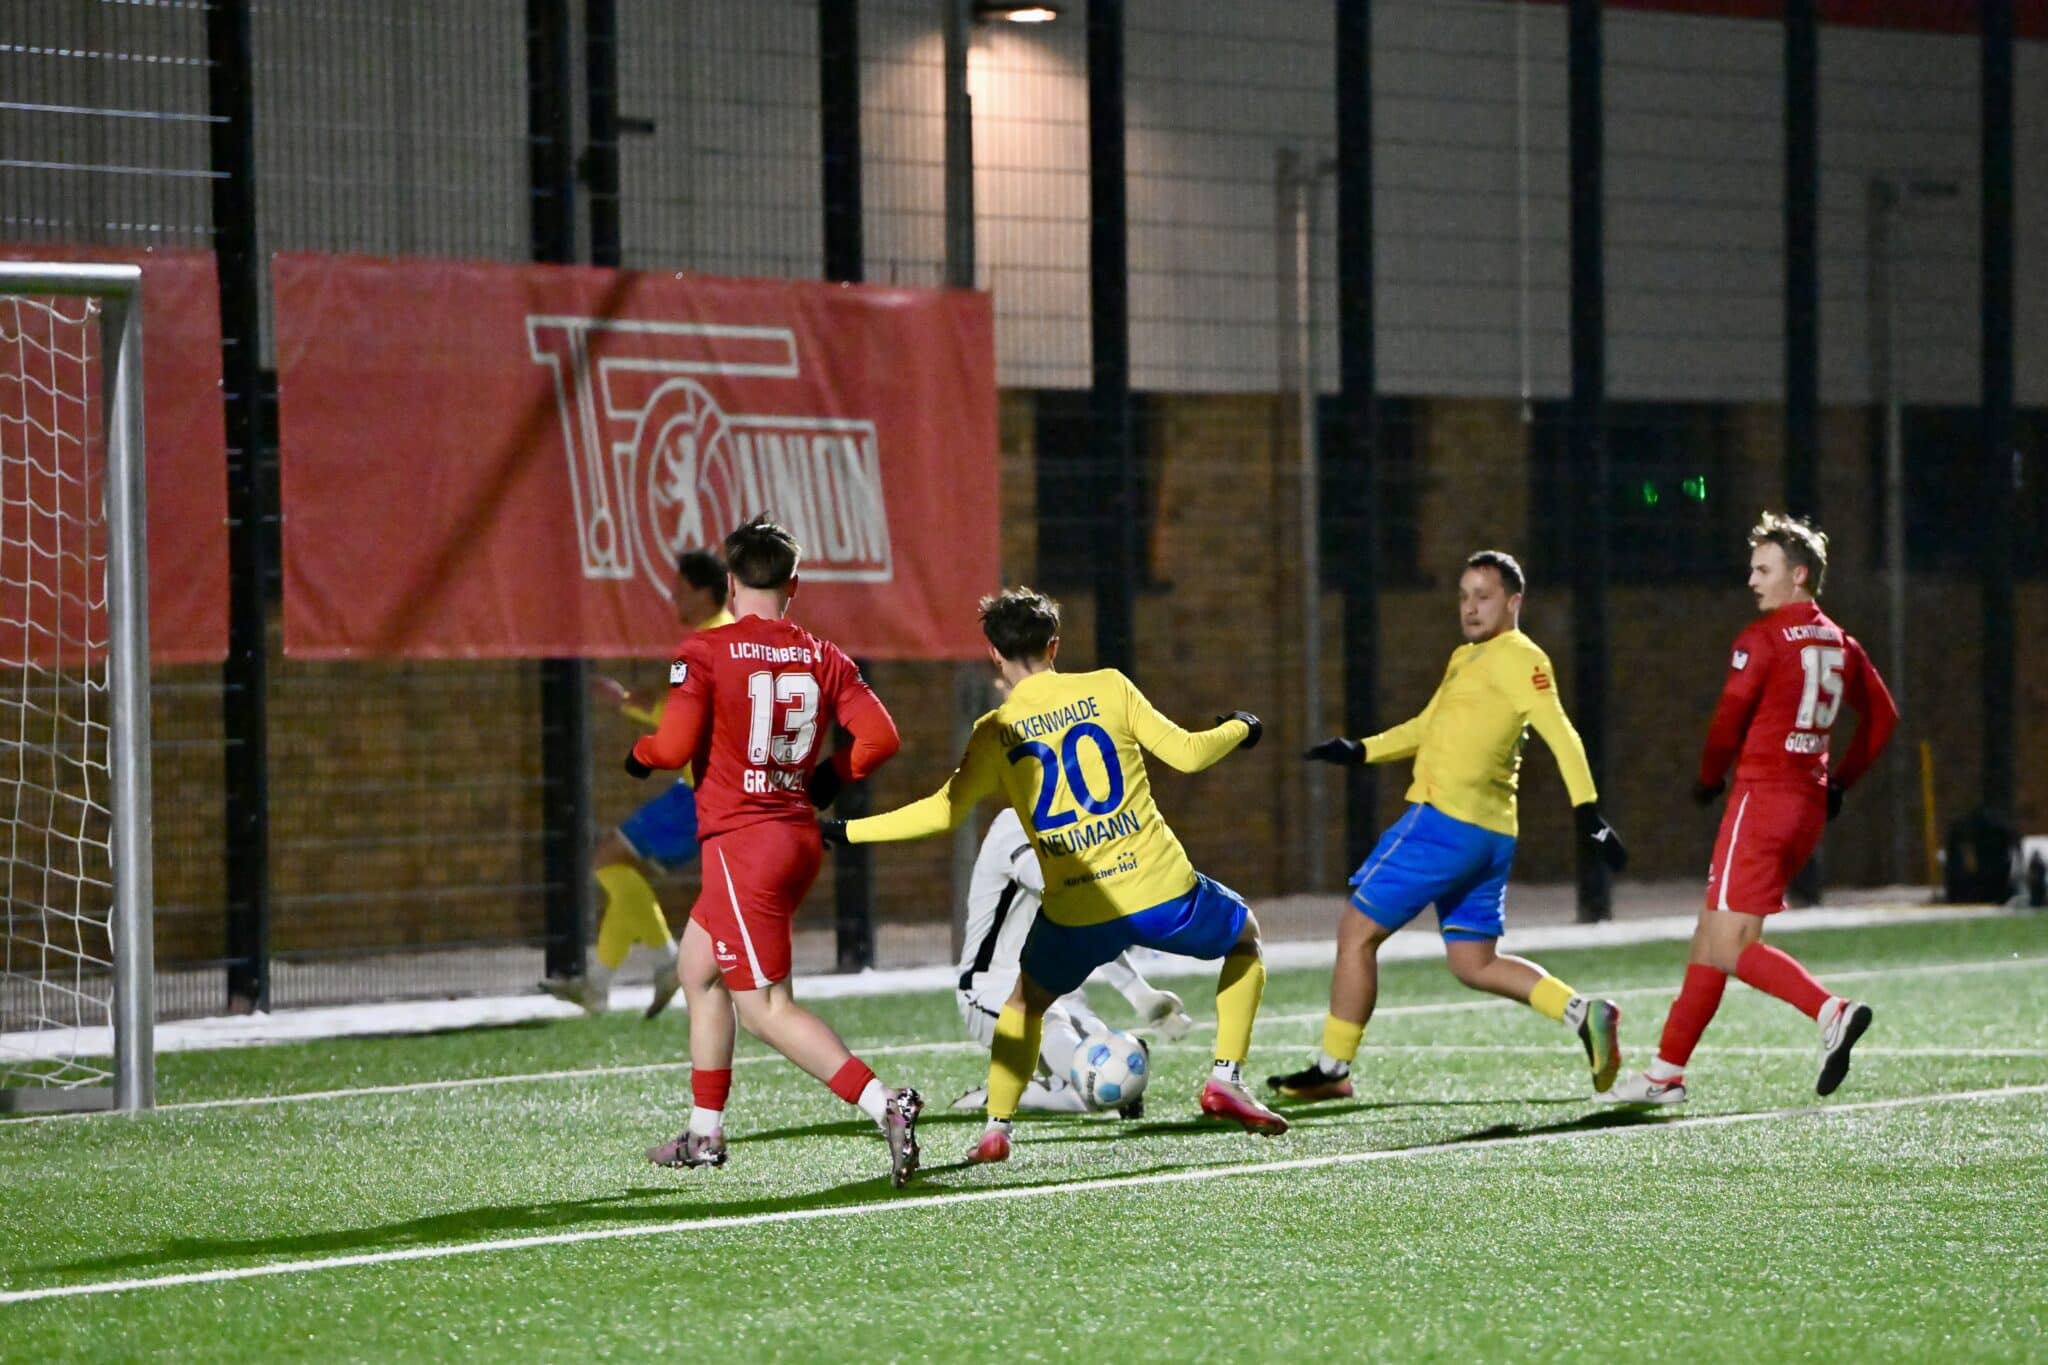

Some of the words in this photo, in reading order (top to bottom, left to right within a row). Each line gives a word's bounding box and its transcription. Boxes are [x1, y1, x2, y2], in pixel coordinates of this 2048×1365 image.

[735, 430, 884, 564] UNION
[729, 642, 811, 664] LICHTENBERG
[1795, 645, 1845, 729] 15
[748, 670, 821, 765] 13
[1006, 722, 1125, 833] 20
[1038, 809, 1140, 858] NEUMANN
[1118, 858, 1138, 873] Hof
